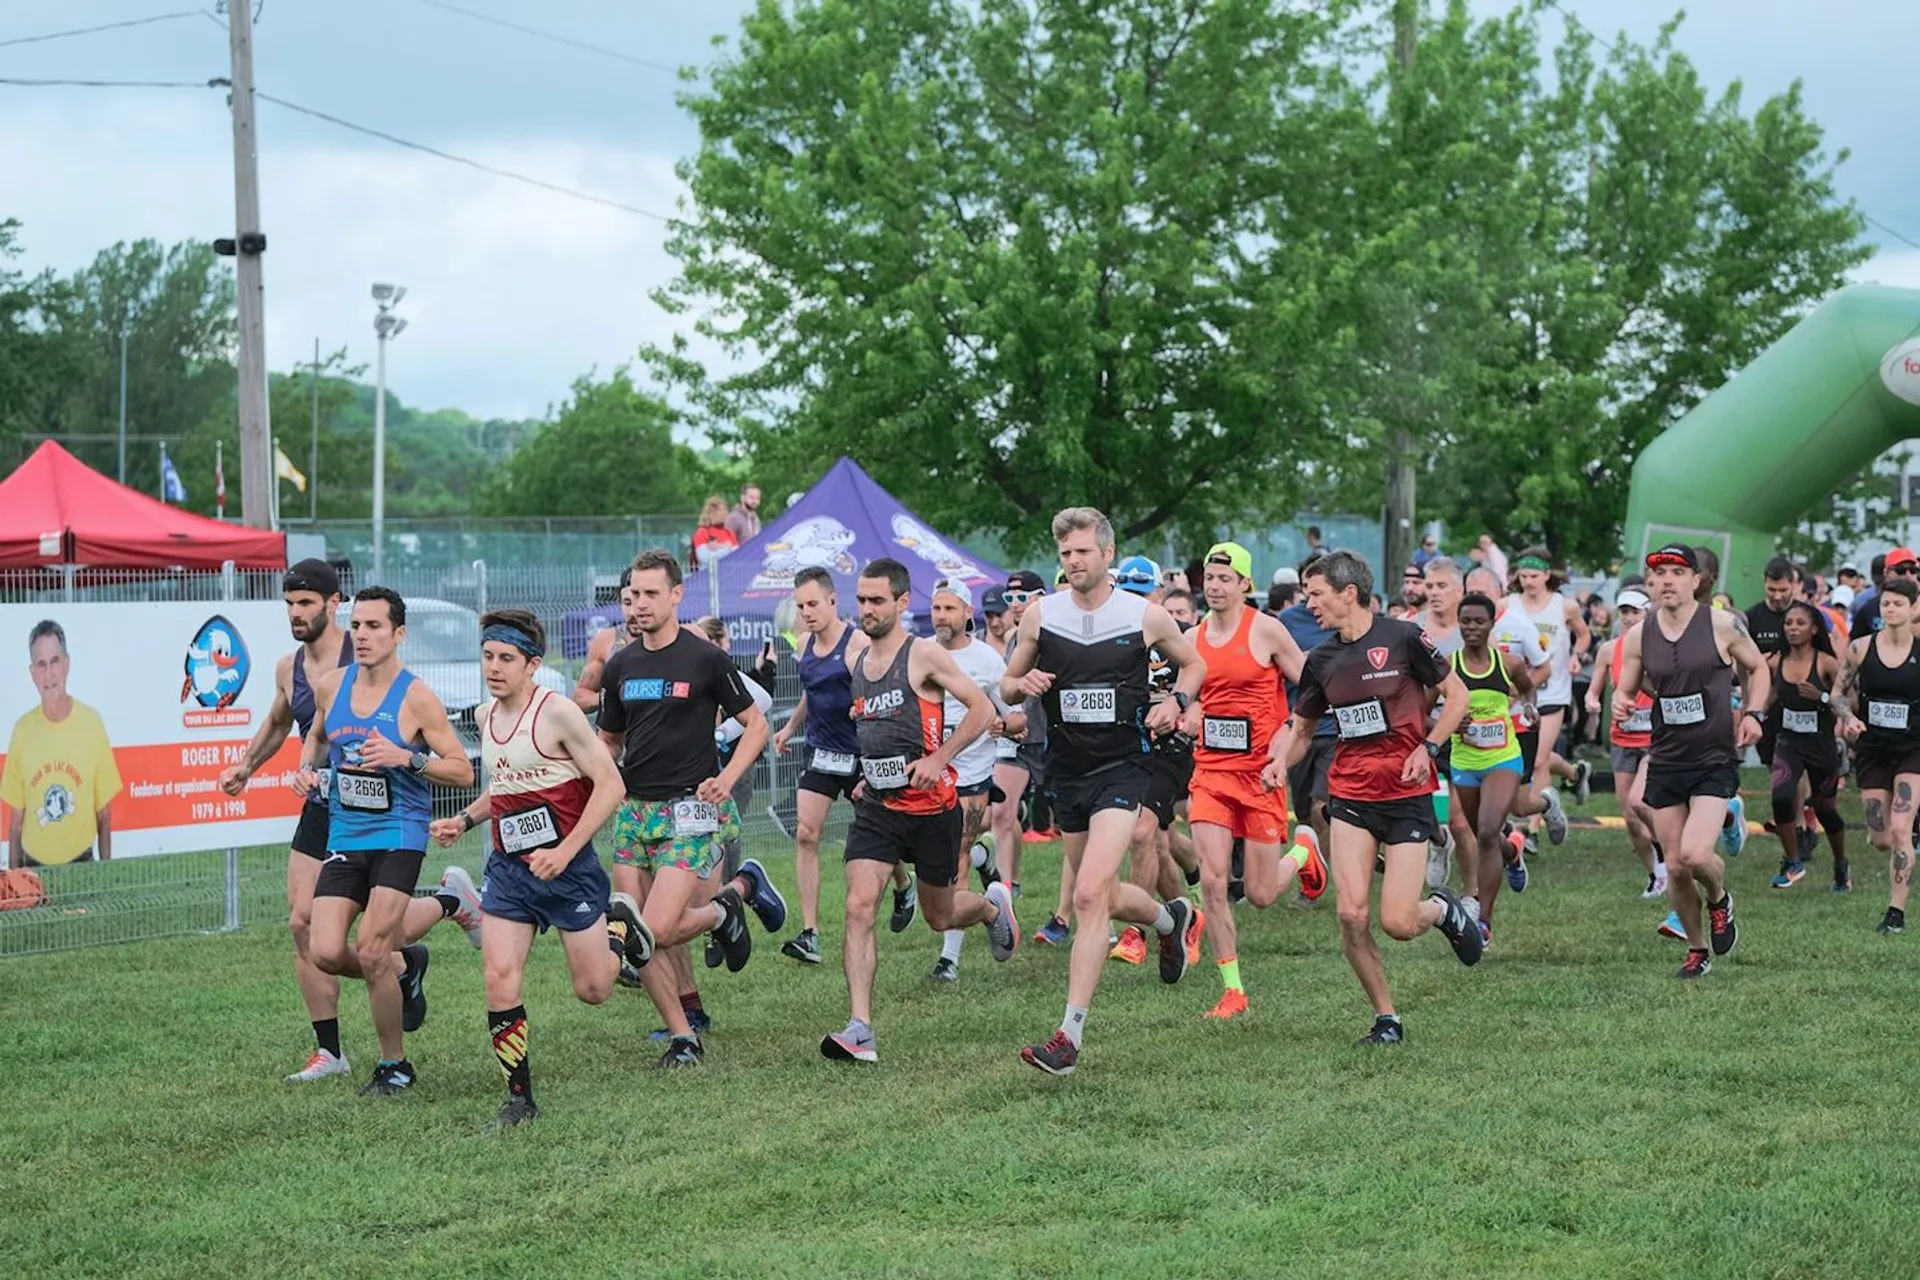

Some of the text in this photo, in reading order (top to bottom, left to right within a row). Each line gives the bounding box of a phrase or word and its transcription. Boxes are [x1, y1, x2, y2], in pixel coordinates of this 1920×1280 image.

[1904, 356, 1920, 374] fo
[730, 616, 780, 641] cbro
[625, 681, 662, 699] COURSE
[663, 682, 672, 697] &
[1081, 692, 1113, 709] 2683
[1674, 697, 1701, 714] 2428
[1352, 705, 1379, 724] 2718
[1884, 705, 1906, 719] 2691
[1219, 723, 1245, 739] 2690
[1481, 725, 1503, 738] 2072
[182, 740, 251, 768] ROGER PAG
[875, 759, 904, 778] 2684
[165, 781, 173, 793] et
[354, 779, 384, 797] 2692
[191, 803, 213, 819] 1979
[223, 801, 247, 817] 1998
[517, 811, 548, 835] 2687
